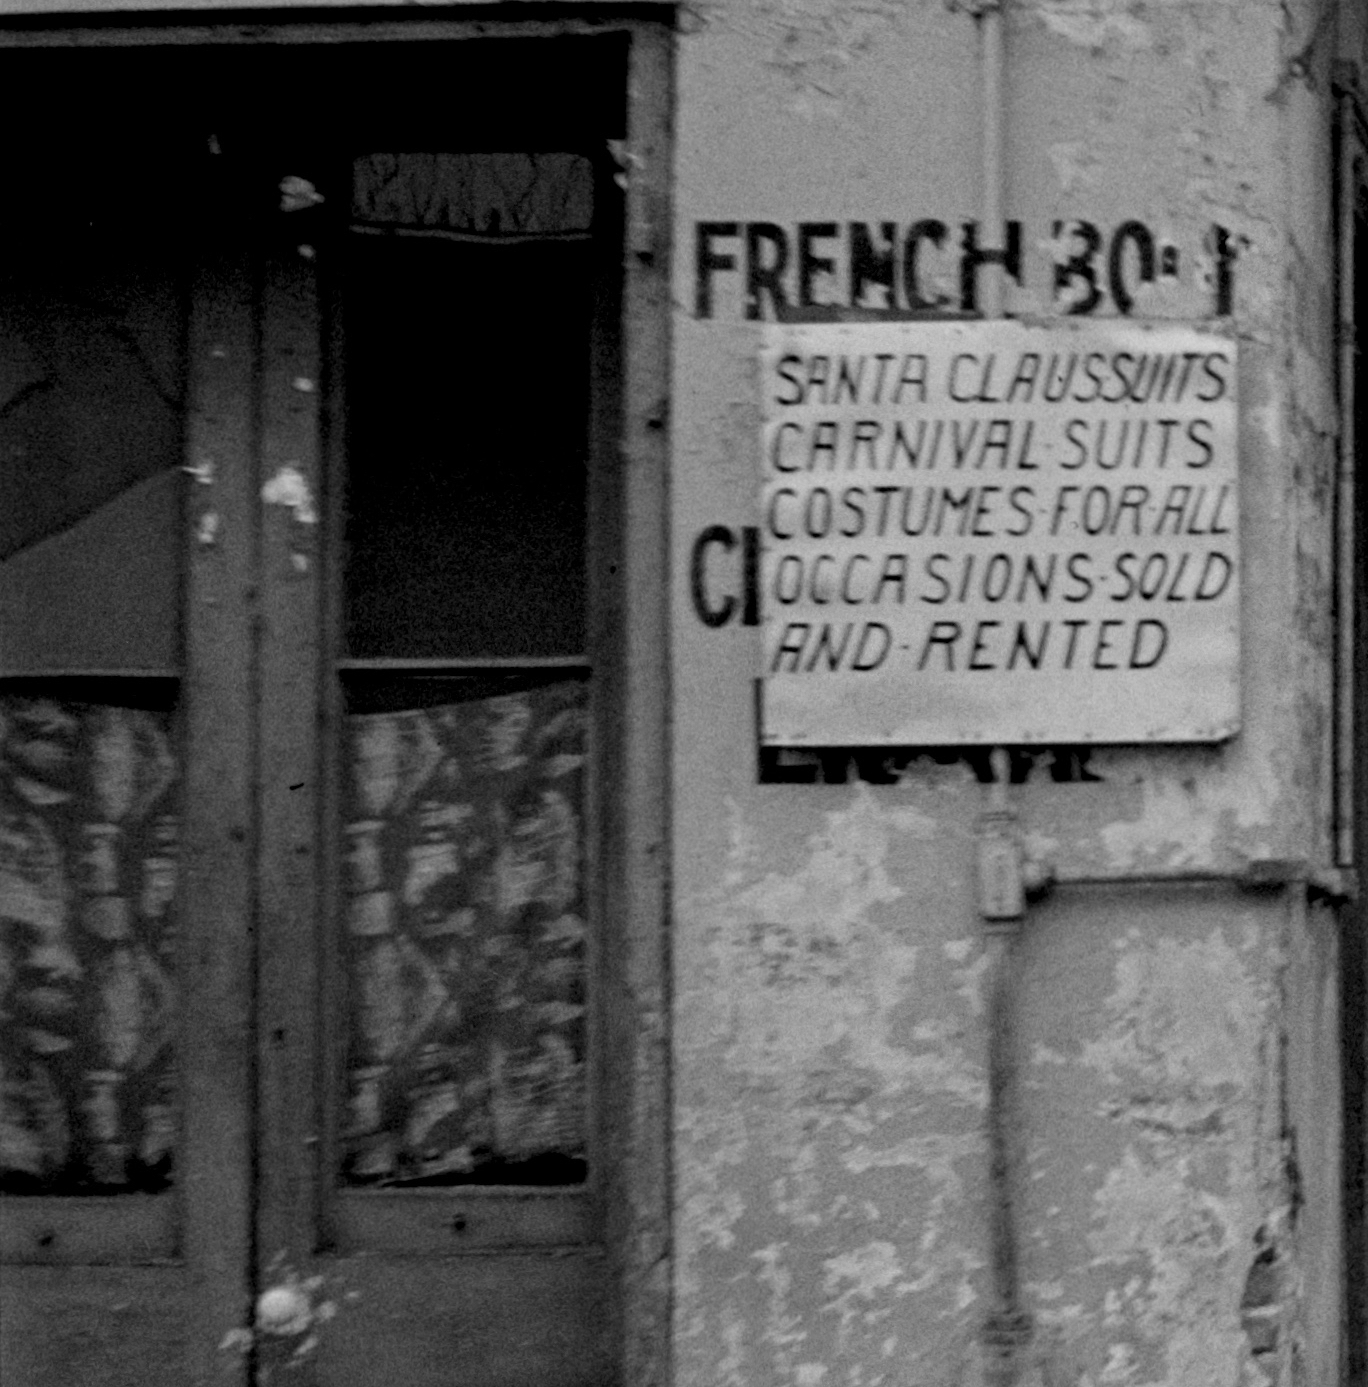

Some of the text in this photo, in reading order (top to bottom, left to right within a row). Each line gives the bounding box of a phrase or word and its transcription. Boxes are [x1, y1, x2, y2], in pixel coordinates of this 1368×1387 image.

[694, 218, 1023, 320] FRENCH
[774, 353, 928, 407] SANTA
[770, 419, 1216, 473] CARNIVAL SUITS
[766, 484, 1231, 539] COSTUMES FOR ALL
[773, 551, 1234, 605] OCCASIONS SOLD
[770, 618, 1170, 673] AND RENTED
